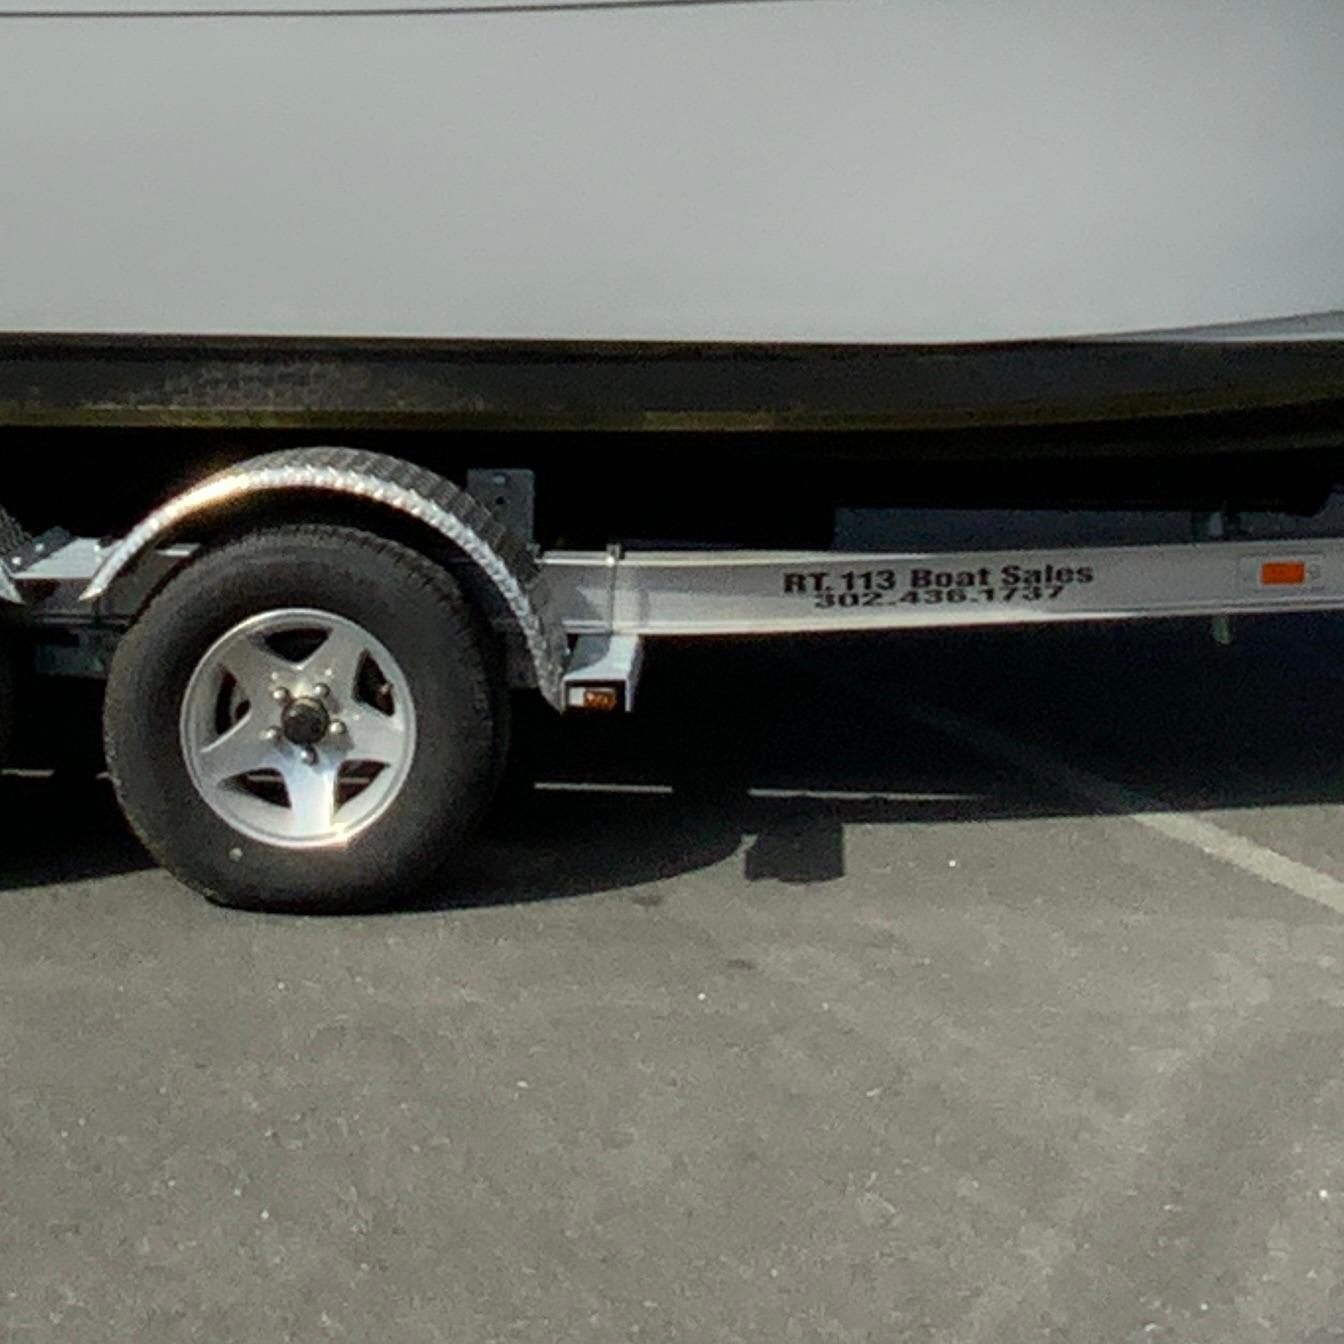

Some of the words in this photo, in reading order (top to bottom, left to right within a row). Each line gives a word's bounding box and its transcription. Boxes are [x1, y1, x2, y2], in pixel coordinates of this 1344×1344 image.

[783, 571, 832, 594] RT.
[842, 569, 896, 591] 113
[910, 567, 991, 589] Boat
[1001, 564, 1094, 586] Sales
